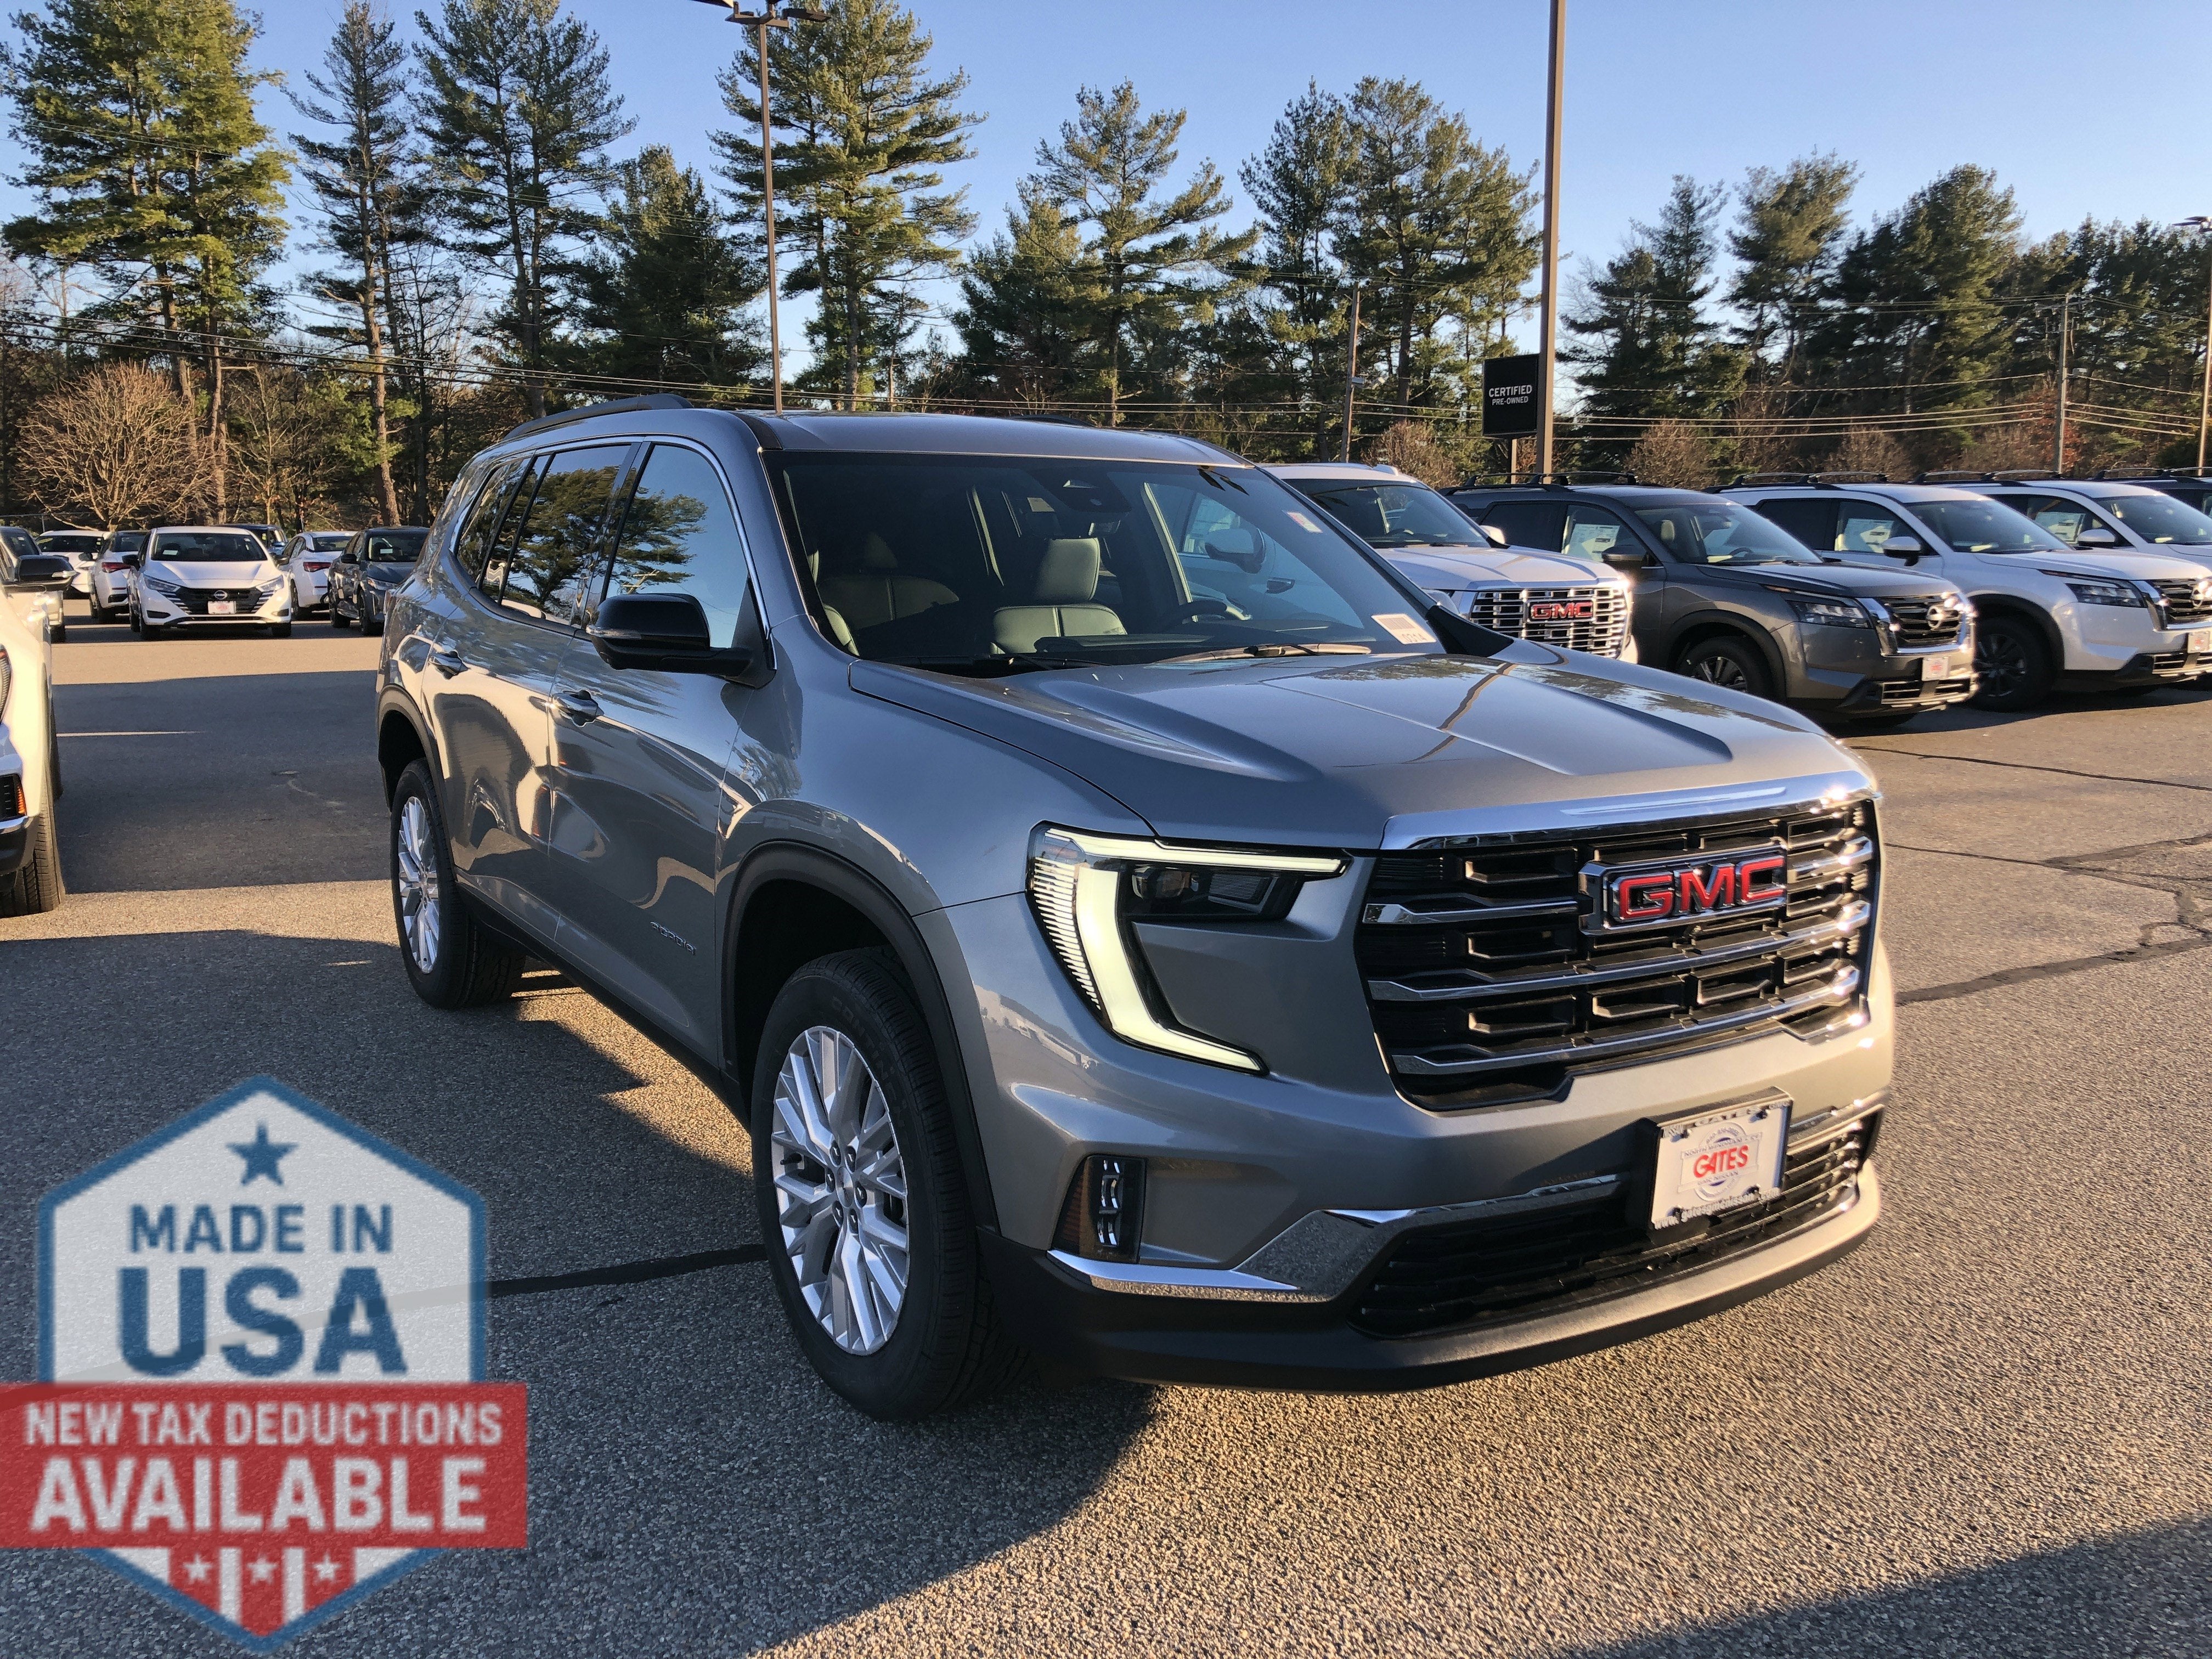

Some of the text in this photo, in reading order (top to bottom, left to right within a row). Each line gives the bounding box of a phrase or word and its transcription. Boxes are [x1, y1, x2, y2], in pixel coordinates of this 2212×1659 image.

[1488, 385, 1532, 397] CERTIFIED
[1492, 396, 1528, 405] PRE-OWNED
[1531, 601, 1593, 619] GMC
[1610, 855, 1786, 922] GMC
[1694, 1145, 1749, 1178] GATES
